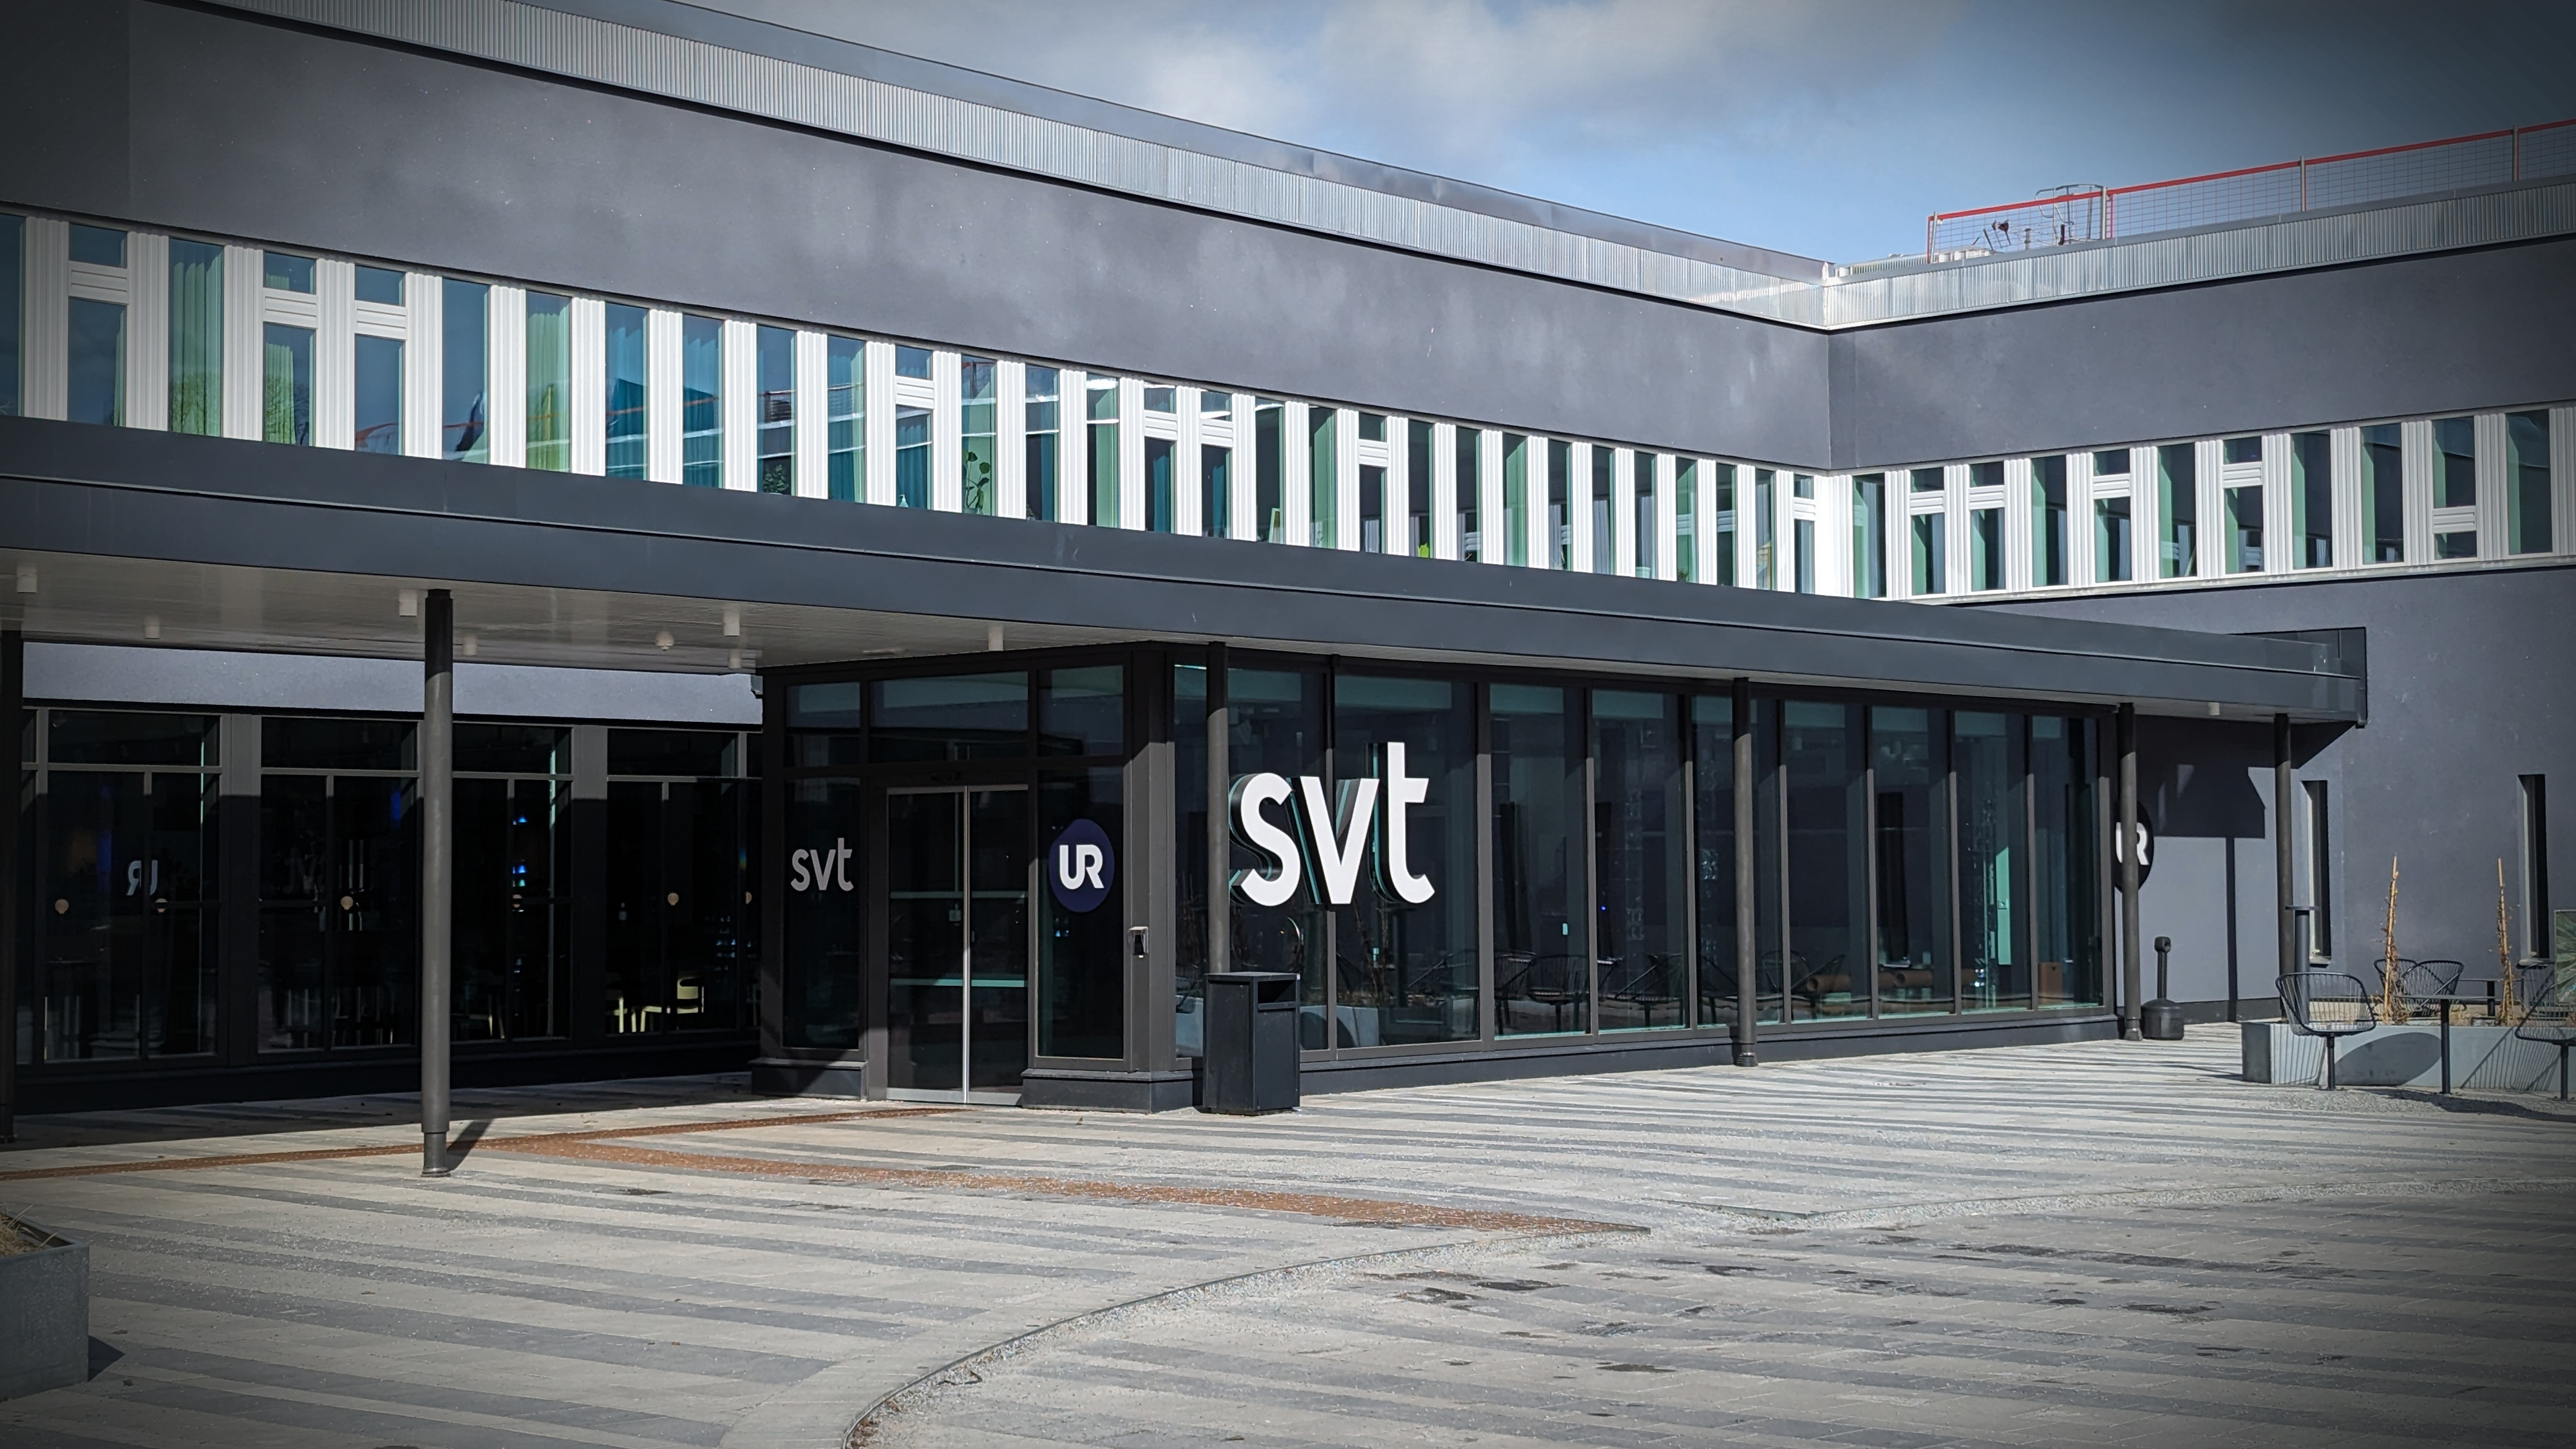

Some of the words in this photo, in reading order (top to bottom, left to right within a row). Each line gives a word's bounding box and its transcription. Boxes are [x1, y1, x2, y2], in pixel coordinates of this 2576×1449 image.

[1240, 742, 1435, 906] svt
[790, 837, 854, 891] svt
[1059, 844, 1105, 890] UR
